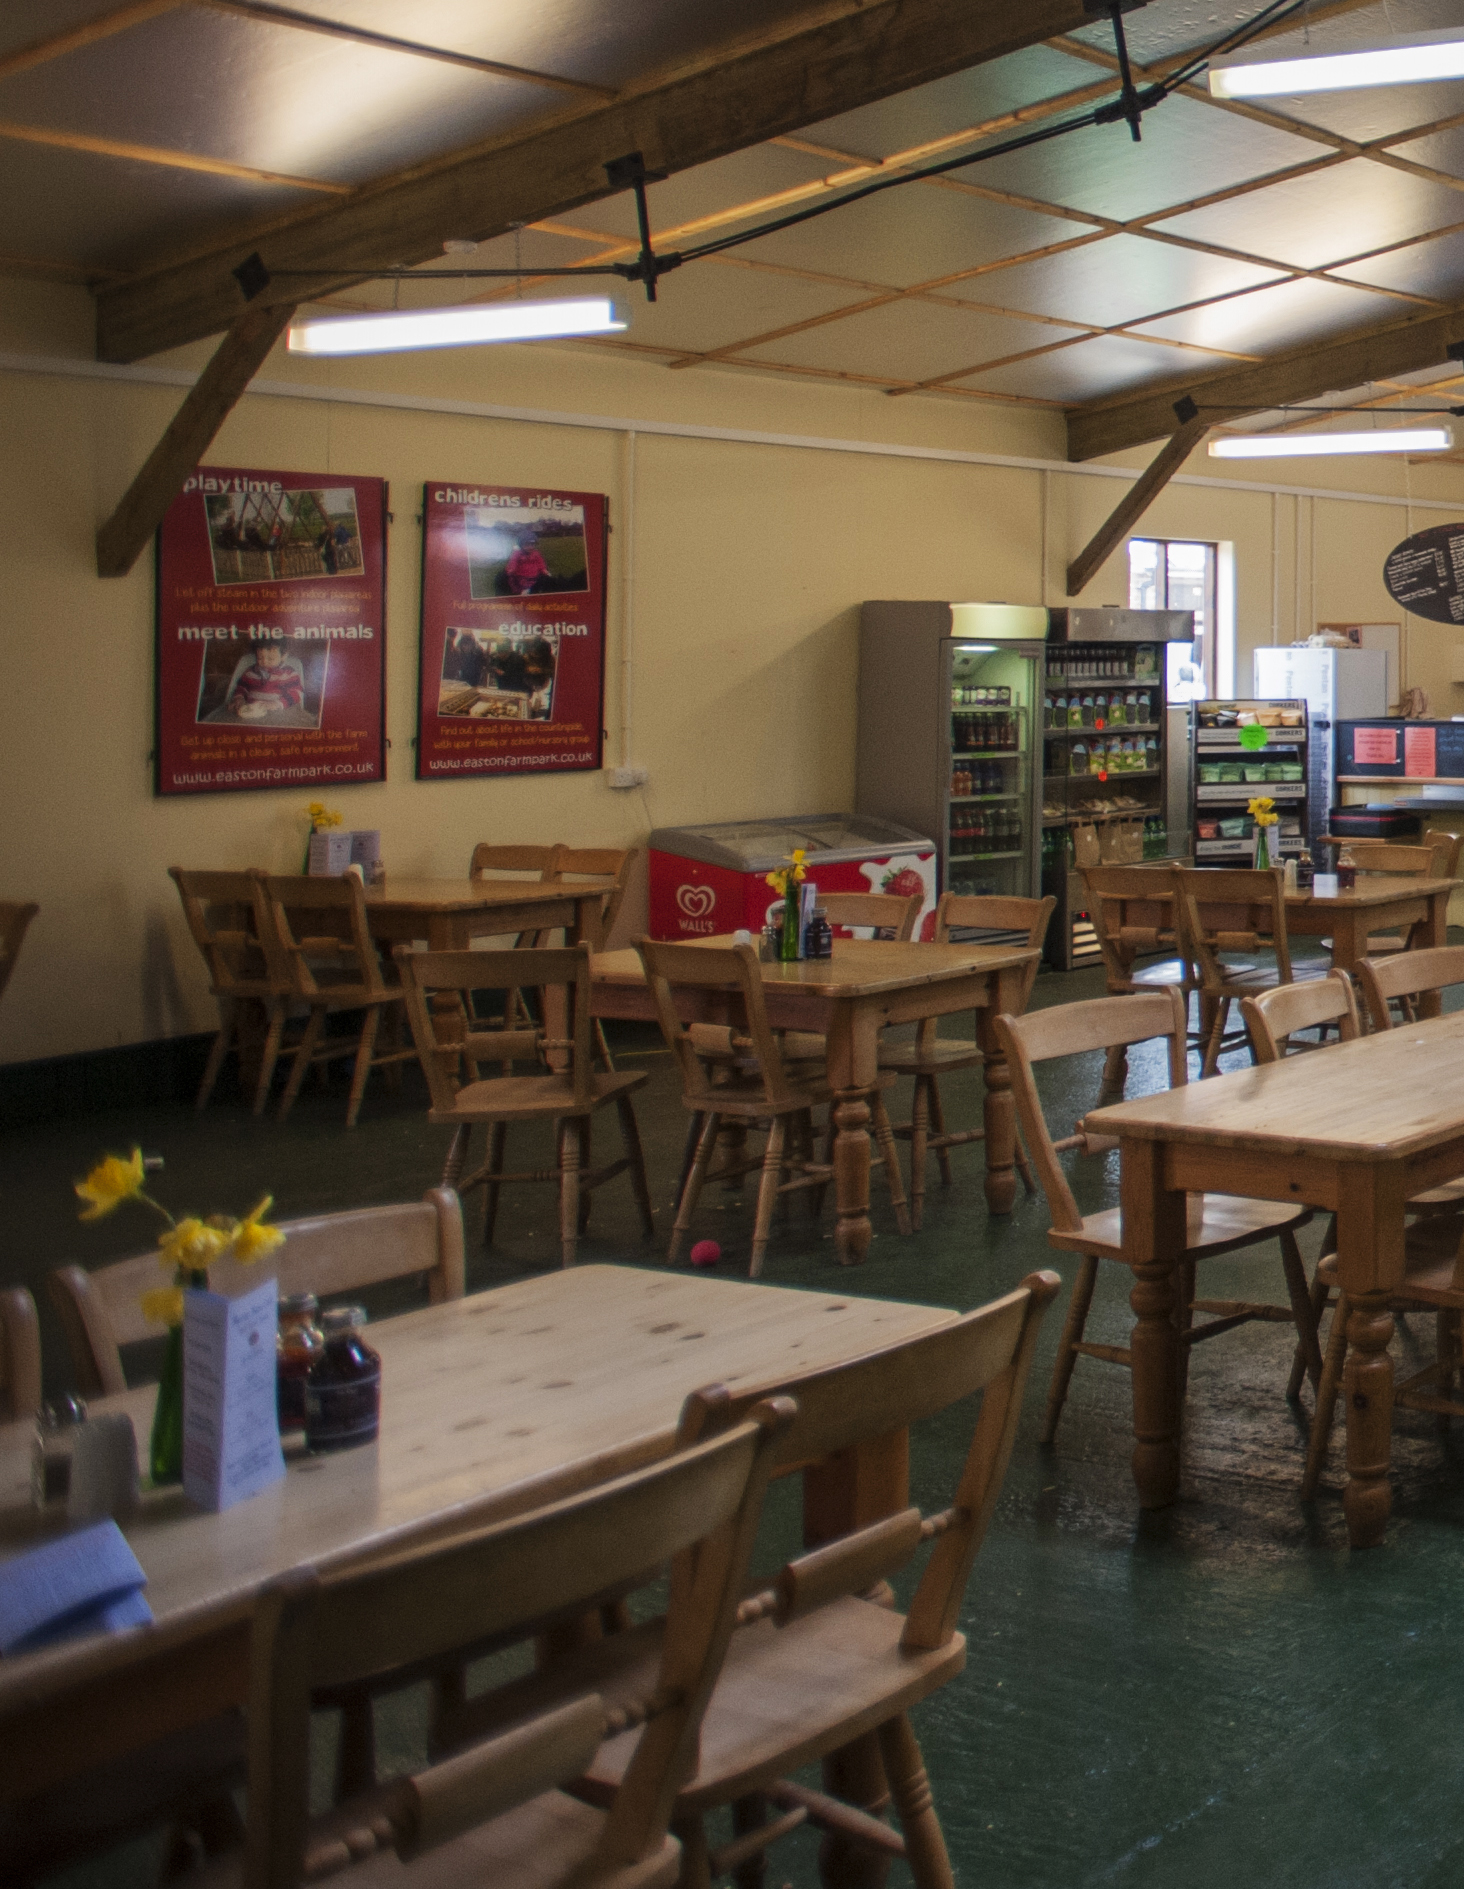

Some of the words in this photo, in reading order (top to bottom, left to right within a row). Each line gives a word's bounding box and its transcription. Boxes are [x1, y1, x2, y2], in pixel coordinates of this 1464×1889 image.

[183, 473, 283, 494] playtime
[434, 488, 521, 507] childrens
[528, 494, 573, 511] rides
[178, 624, 239, 640] meet
[248, 623, 285, 640] the
[293, 624, 374, 640] animals
[499, 620, 588, 636] education
[430, 751, 593, 770] www.eastonfarmpark.co.uk
[172, 762, 374, 786] www.eastonfarmpark.co.uk
[679, 920, 714, 933] WALL'S
